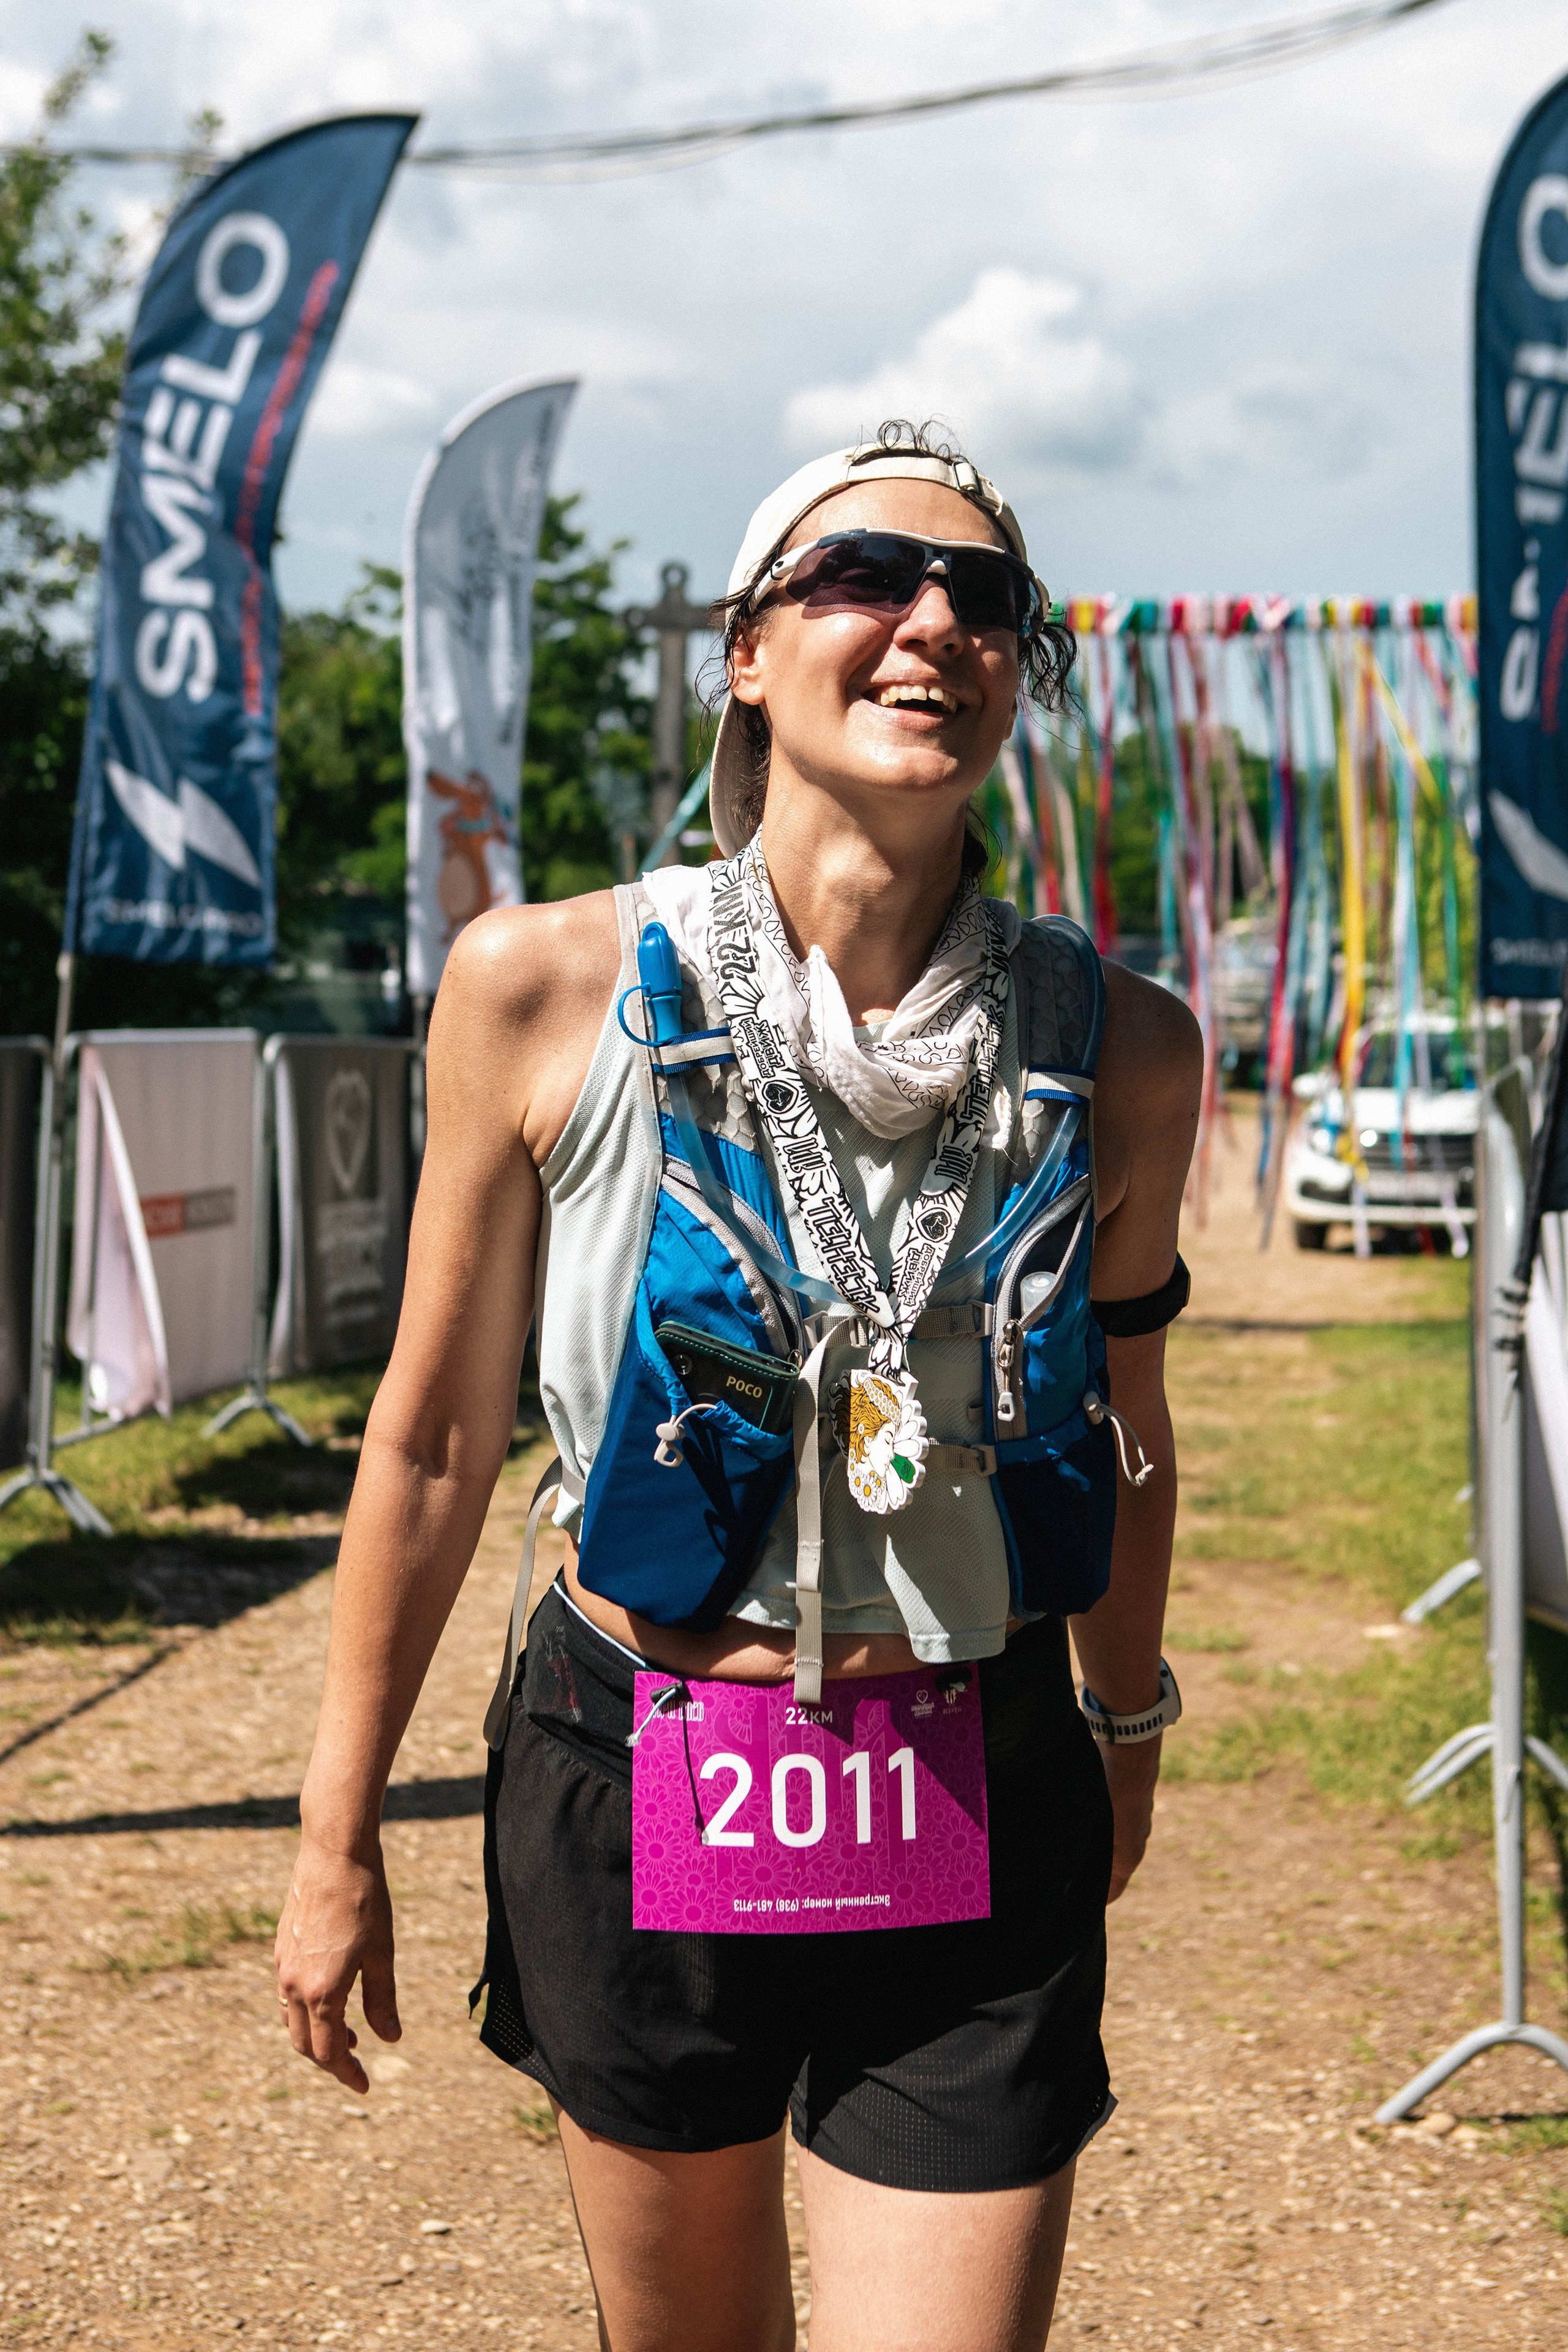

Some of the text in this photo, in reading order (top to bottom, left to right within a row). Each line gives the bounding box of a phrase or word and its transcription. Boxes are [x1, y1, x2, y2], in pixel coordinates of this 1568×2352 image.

[135, 211, 290, 703] SMELO
[717, 936, 756, 980] 22
[742, 1019, 771, 1077] ДОБРЕЙШИЙ
[756, 1021, 783, 1067] ДВИЖ
[901, 1250, 921, 1295] ДВИЖ
[907, 1246, 933, 1305] ДОБРЕЙШИЙ
[726, 1375, 763, 1398] POCO
[699, 1747, 917, 1849] 2011
[734, 1899, 773, 1912] 481-9113
[775, 1898, 799, 1912] (938)
[801, 1896, 832, 1909] номер:
